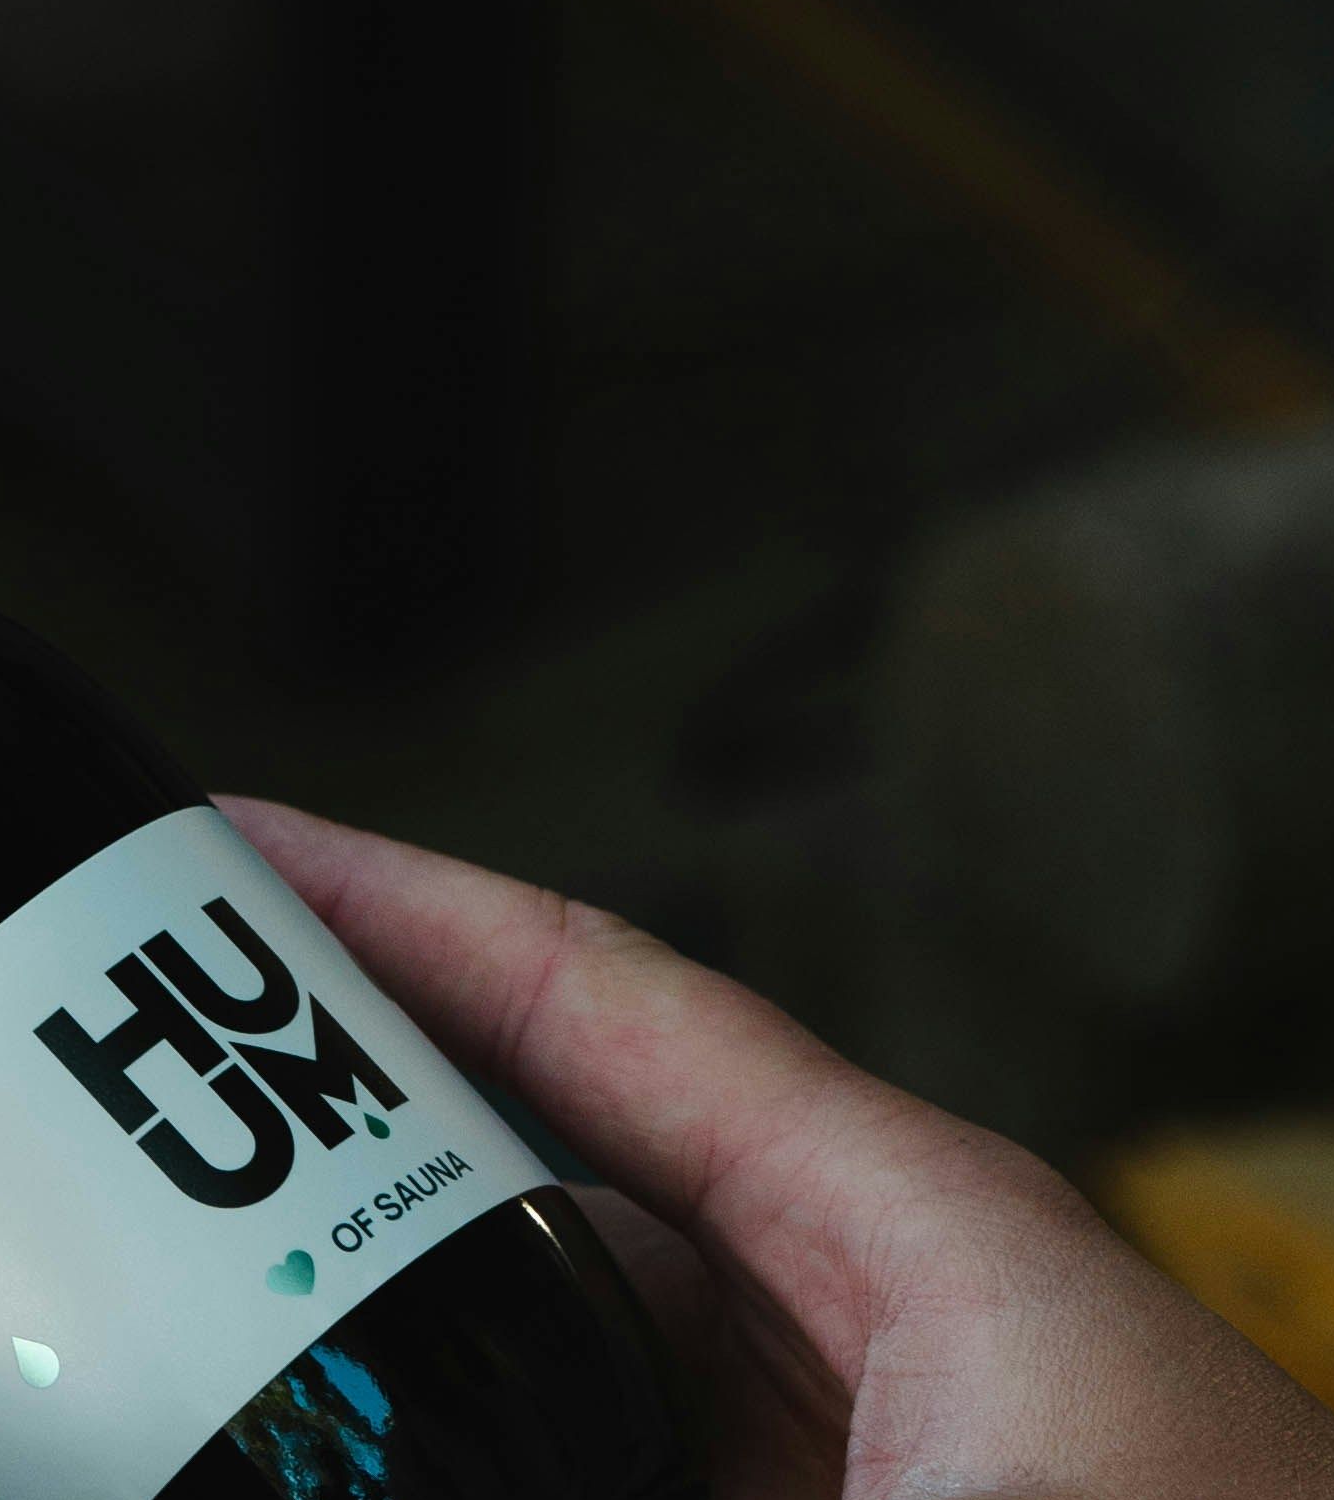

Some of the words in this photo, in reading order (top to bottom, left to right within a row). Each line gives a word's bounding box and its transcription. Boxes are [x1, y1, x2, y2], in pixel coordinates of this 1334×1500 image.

[33, 896, 300, 1136] HU
[135, 992, 410, 1209] UM
[331, 1207, 375, 1253] OF
[373, 1150, 474, 1221] SAUNA
